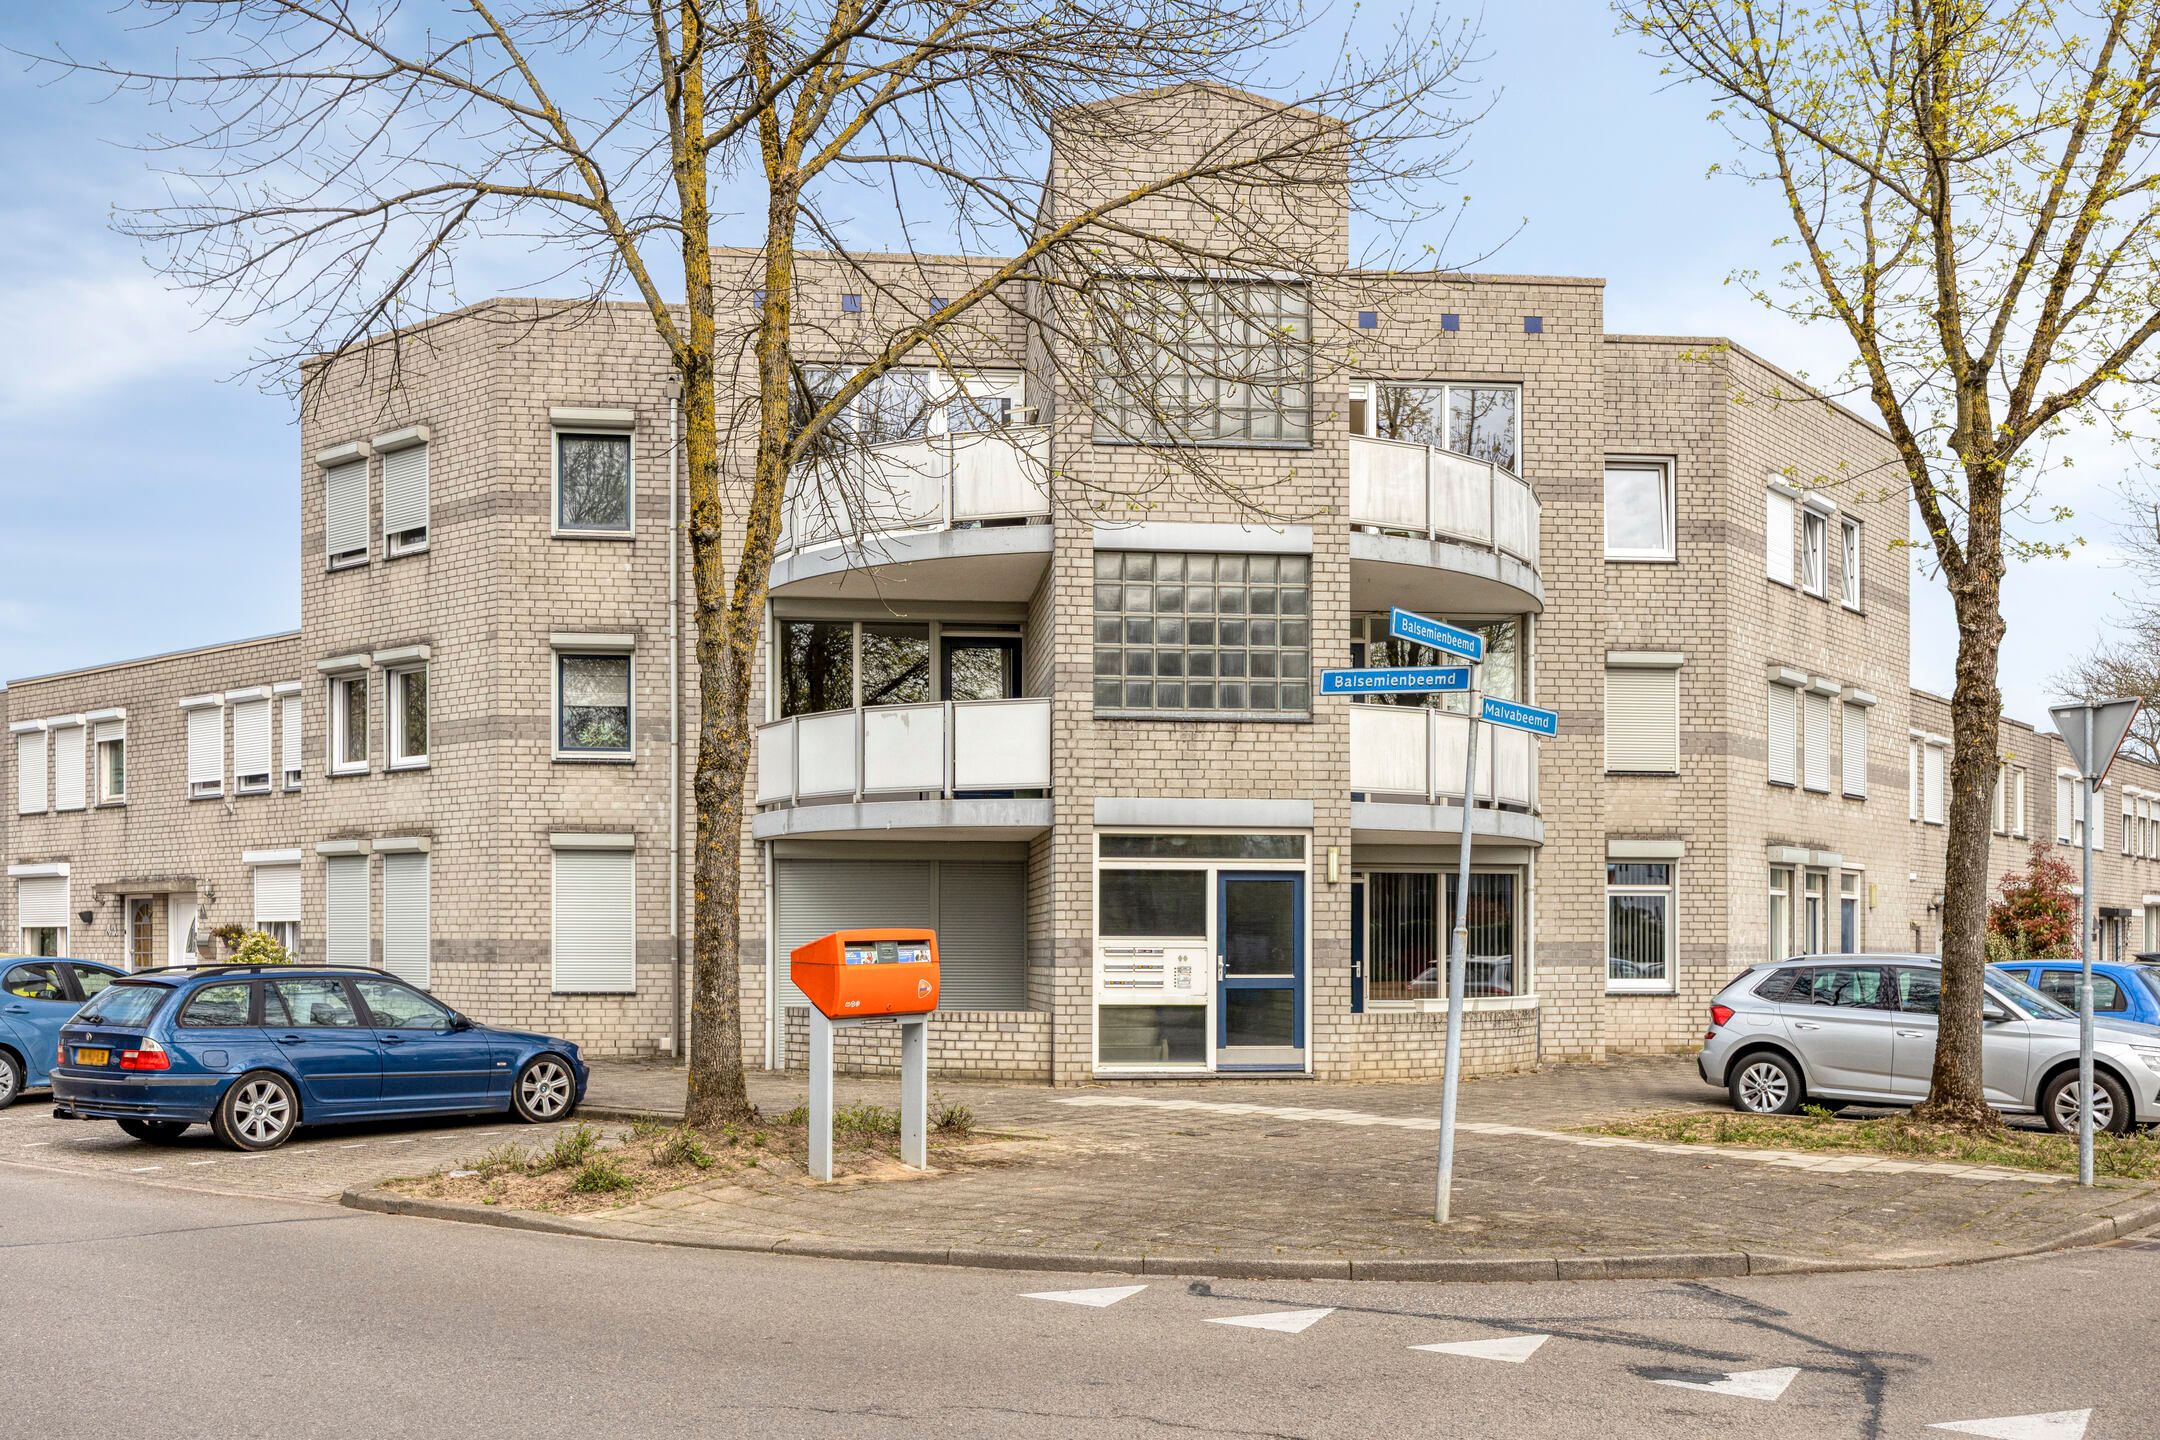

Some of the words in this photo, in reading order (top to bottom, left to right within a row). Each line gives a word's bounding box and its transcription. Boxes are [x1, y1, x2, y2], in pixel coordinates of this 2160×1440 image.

[1402, 618, 1475, 652] Balsemienbeemd
[1334, 672, 1456, 688] Balsemienbeemd
[1485, 702, 1549, 728] Malvabeemd
